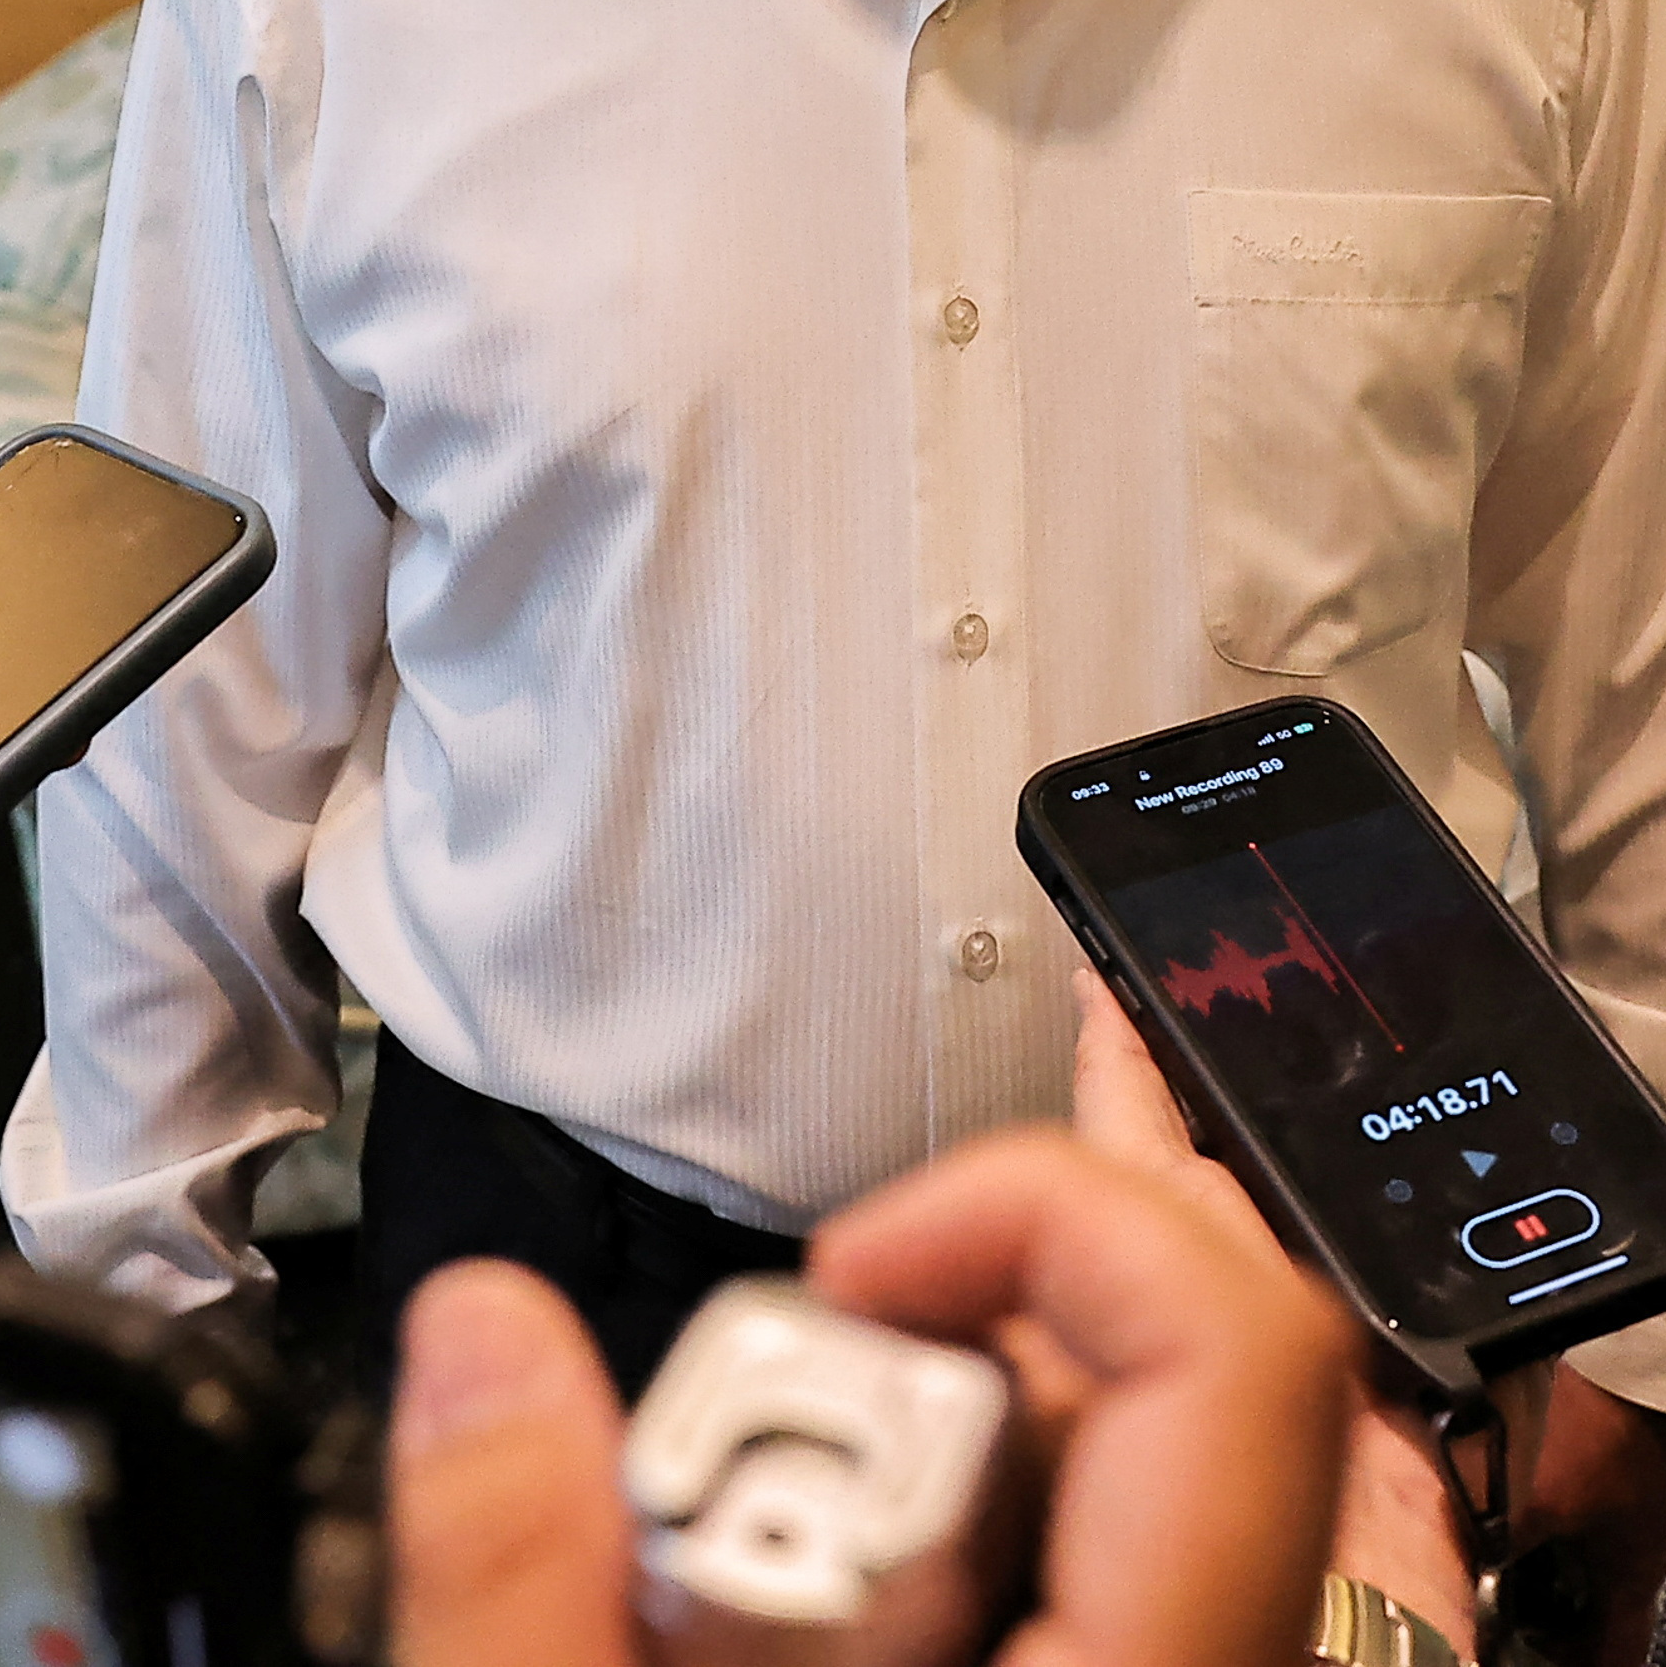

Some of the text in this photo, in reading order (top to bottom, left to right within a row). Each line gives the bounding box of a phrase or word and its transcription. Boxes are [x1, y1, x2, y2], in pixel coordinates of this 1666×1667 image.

[1071, 782, 1110, 801] 09:33
[1134, 757, 1284, 811] New Recording 89
[1361, 1070, 1519, 1141] 04:18.71
